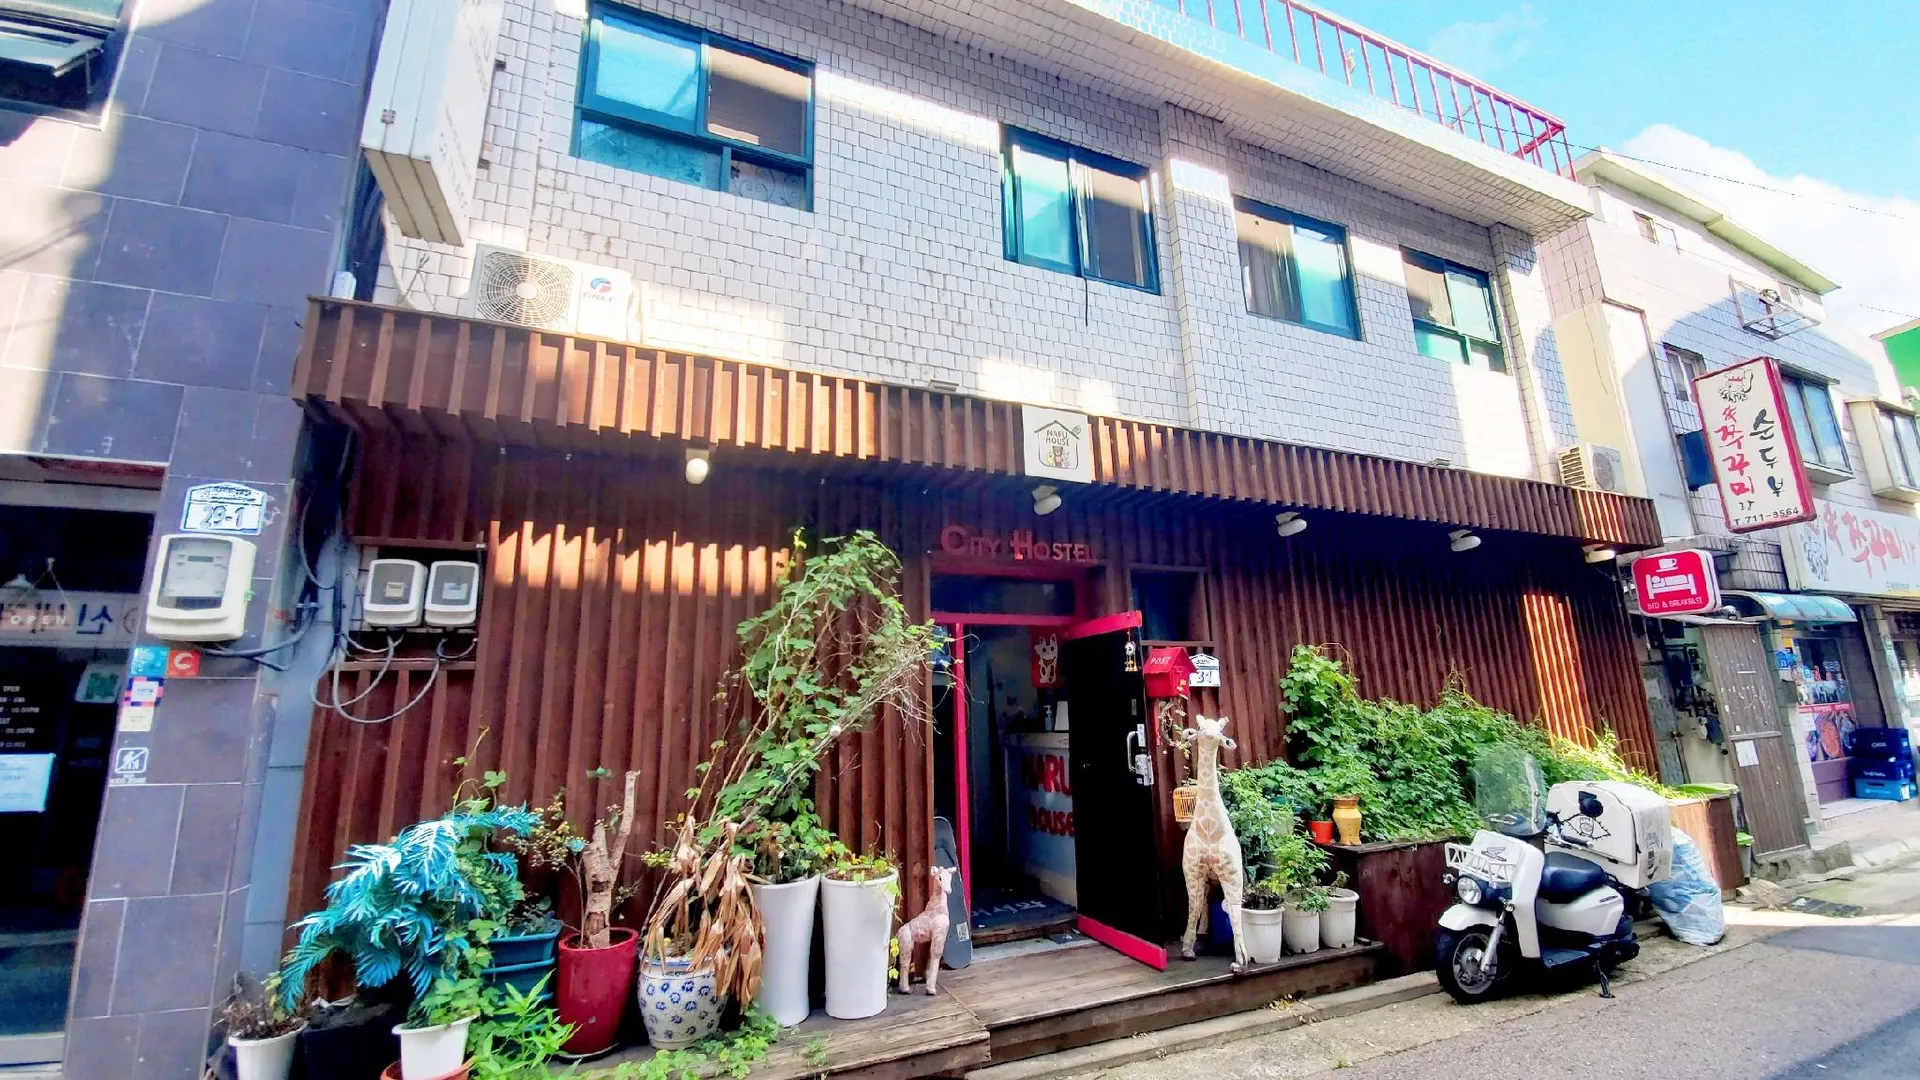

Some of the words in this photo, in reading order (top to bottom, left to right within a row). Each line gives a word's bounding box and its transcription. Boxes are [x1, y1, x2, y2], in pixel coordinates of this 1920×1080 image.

[1045, 436, 1070, 447] HOUSE
[200, 505, 245, 529] 29-1
[1647, 602, 1660, 610] BED
[10, 614, 68, 625] OPEN
[1150, 655, 1172, 665] POST
